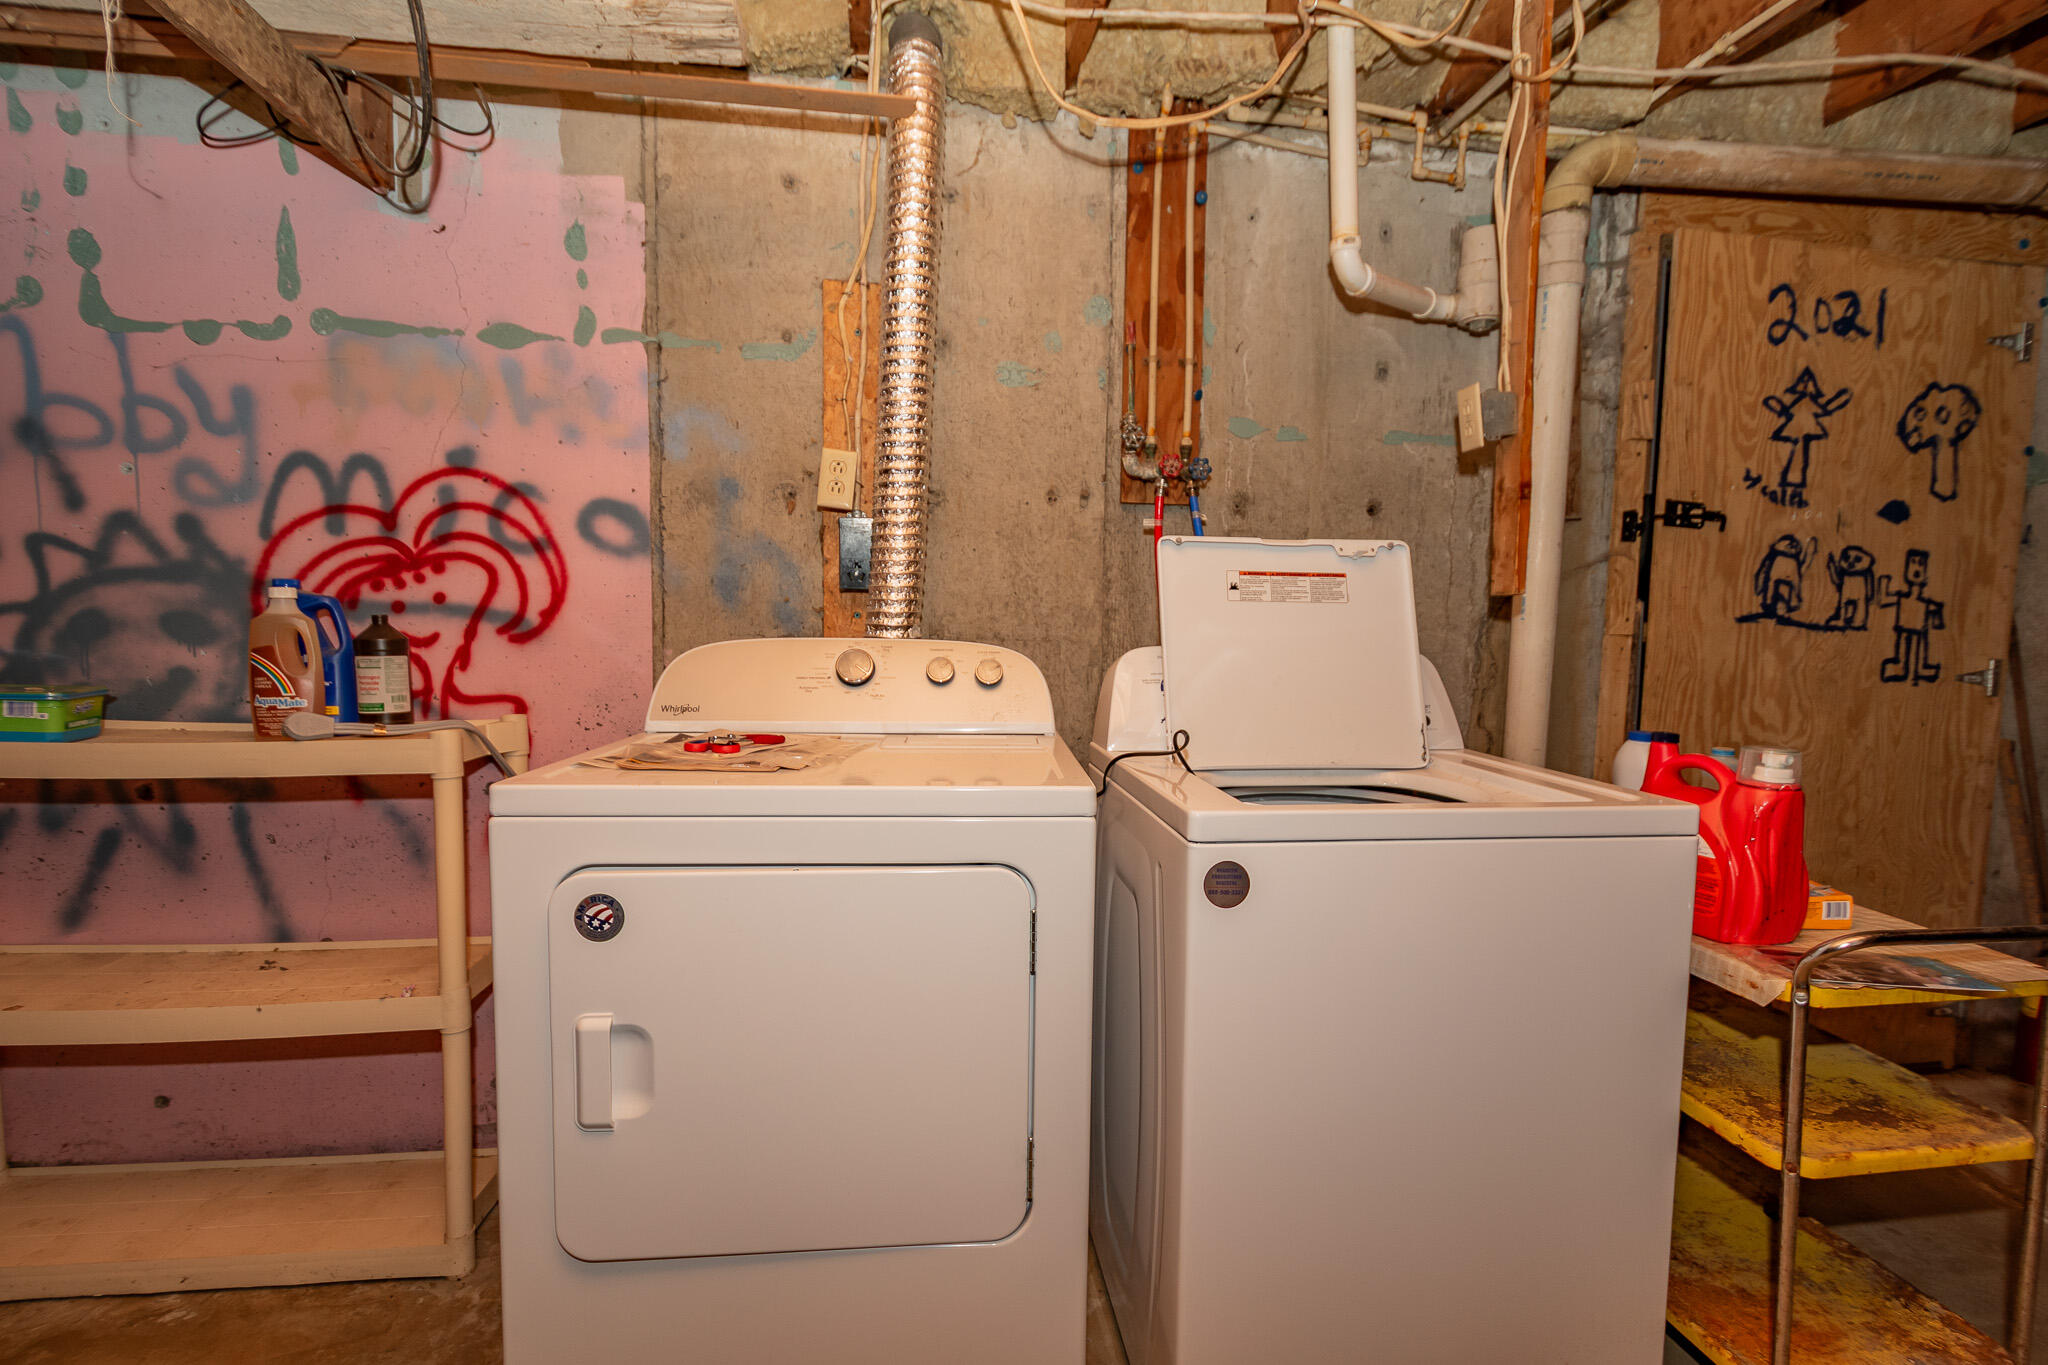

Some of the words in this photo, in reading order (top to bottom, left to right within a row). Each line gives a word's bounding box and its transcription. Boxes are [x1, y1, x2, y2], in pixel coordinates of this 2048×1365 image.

[1767, 283, 1888, 350] 2021
[254, 694, 308, 709] AquaMate
[660, 704, 700, 716] Whirlpool
